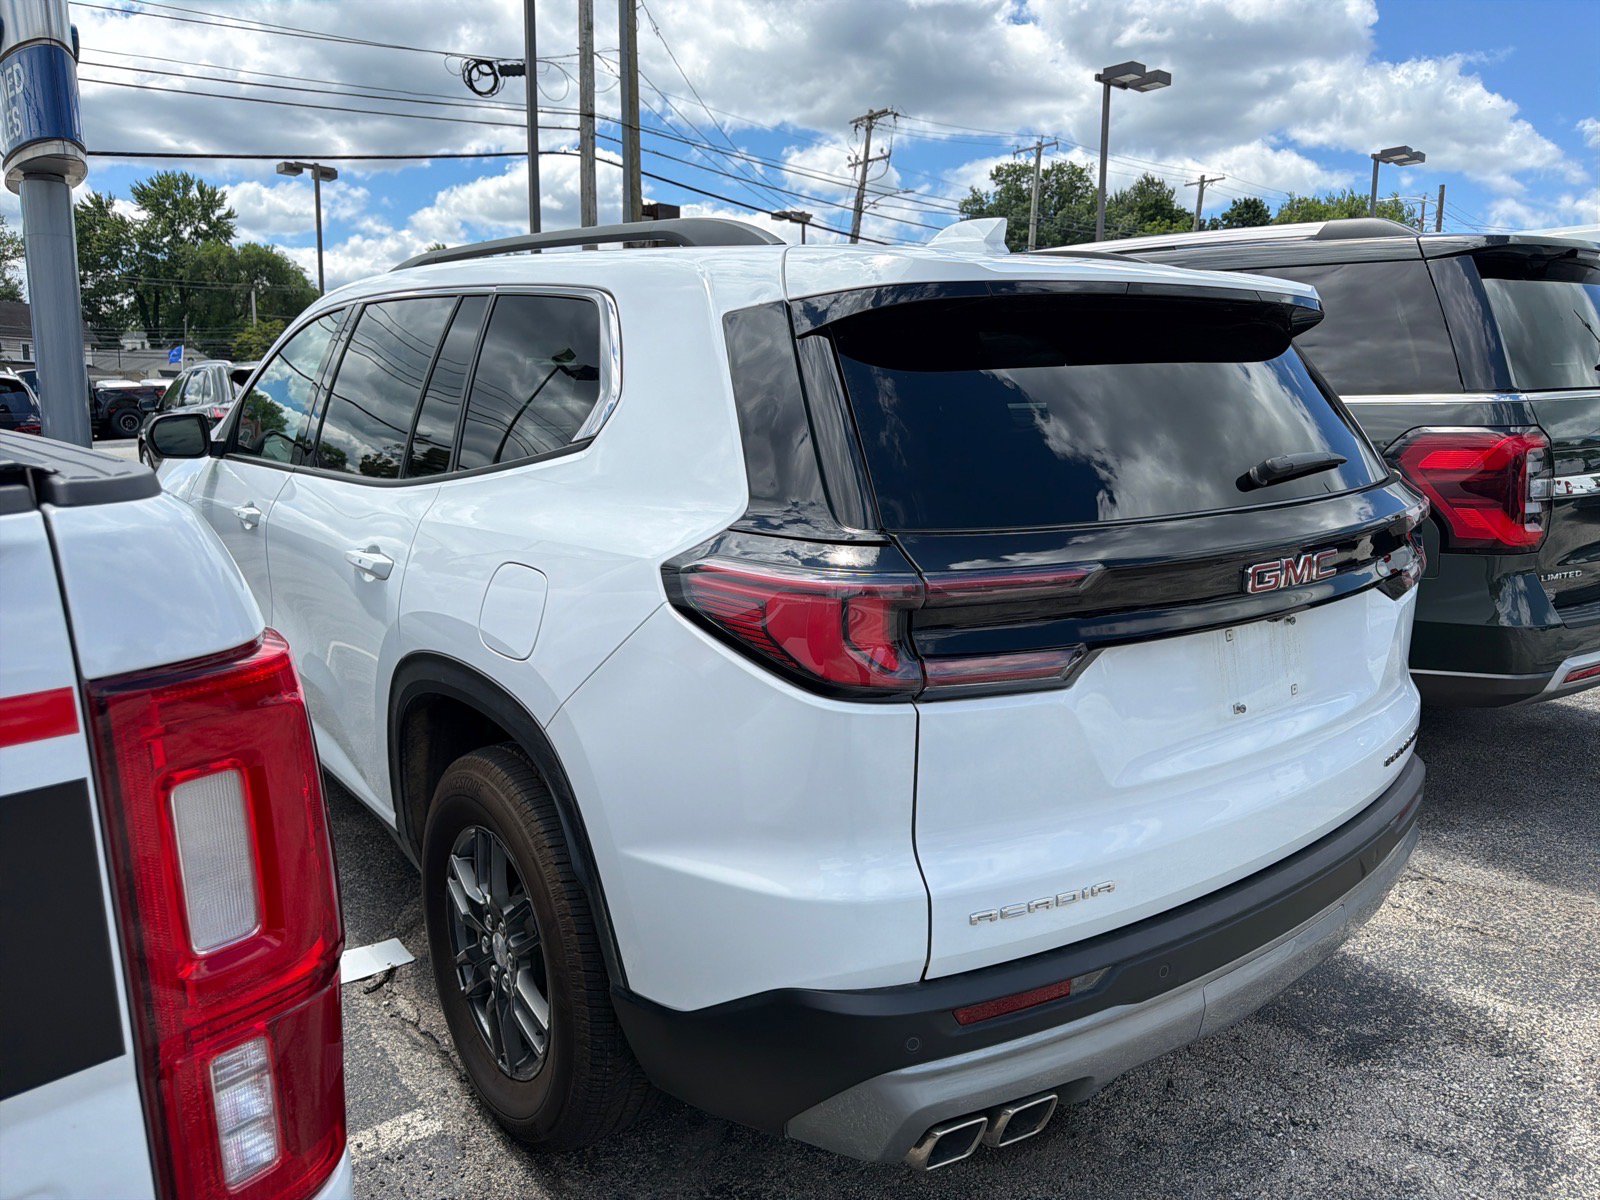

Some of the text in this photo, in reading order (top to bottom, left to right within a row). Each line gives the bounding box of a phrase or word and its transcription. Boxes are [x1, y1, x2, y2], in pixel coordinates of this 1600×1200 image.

[1248, 548, 1338, 594] GMC
[1540, 570, 1583, 582] LIMITED
[969, 880, 1116, 926] ACADIA
